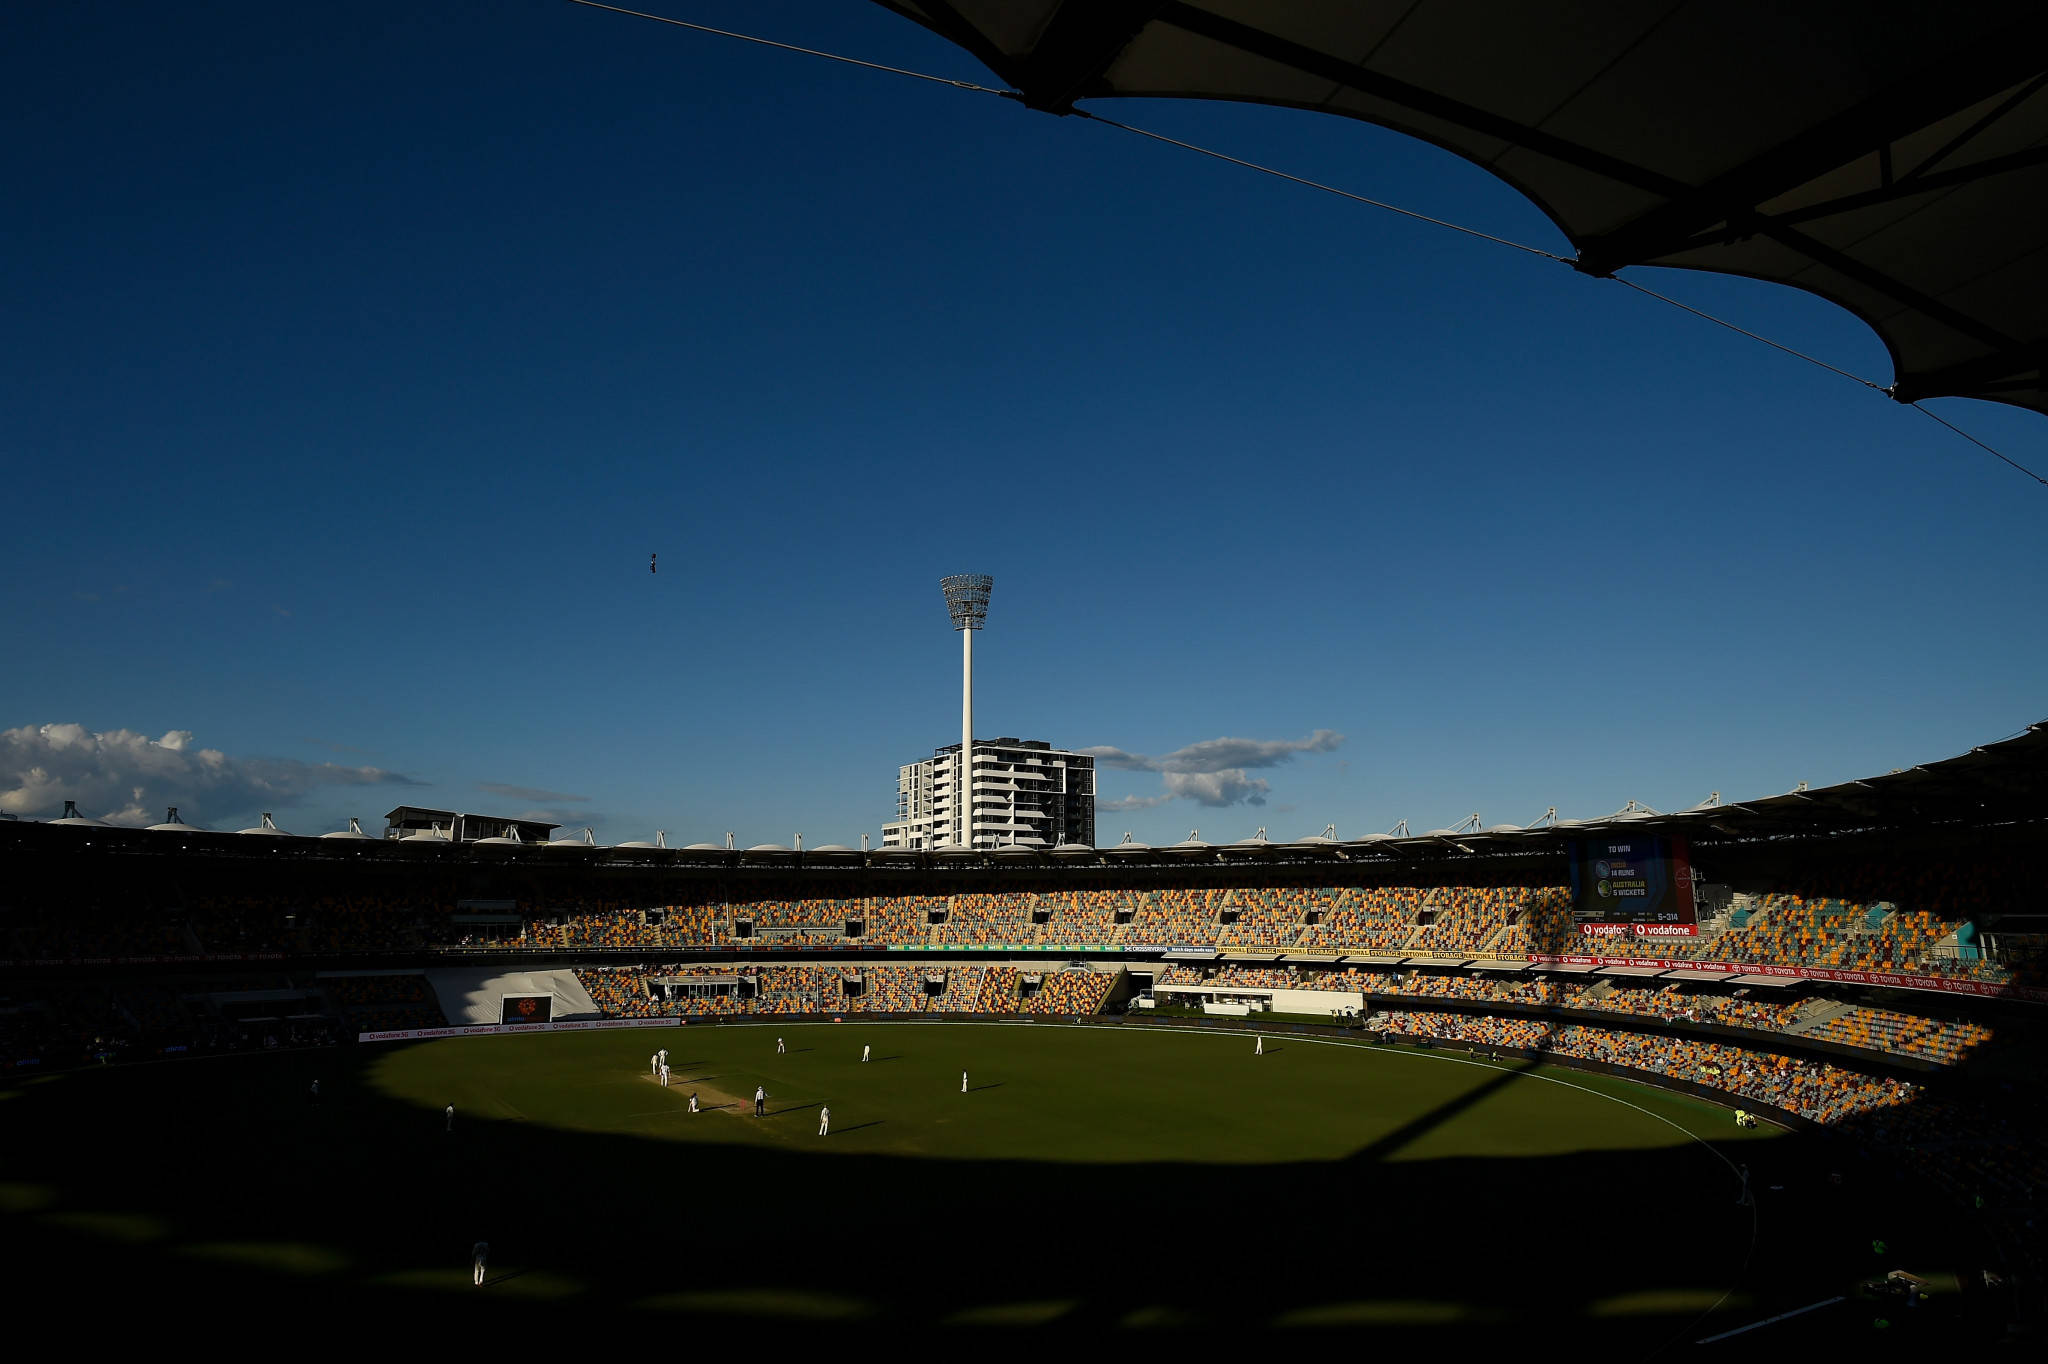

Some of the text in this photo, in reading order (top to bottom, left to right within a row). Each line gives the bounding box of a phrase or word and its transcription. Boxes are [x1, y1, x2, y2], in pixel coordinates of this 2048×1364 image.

[1608, 845, 1616, 853] TO
[1619, 888, 1645, 896] WICKETS
[1594, 925, 1627, 934] vodafo
[1647, 925, 1690, 935] vodafone
[1808, 970, 1830, 978] TOYOTA
[1843, 973, 1865, 981] TOYOTA
[1879, 976, 1902, 984] TOYOTA
[1914, 979, 1938, 987] TOYOTA
[1953, 982, 1976, 992] TOYOTA
